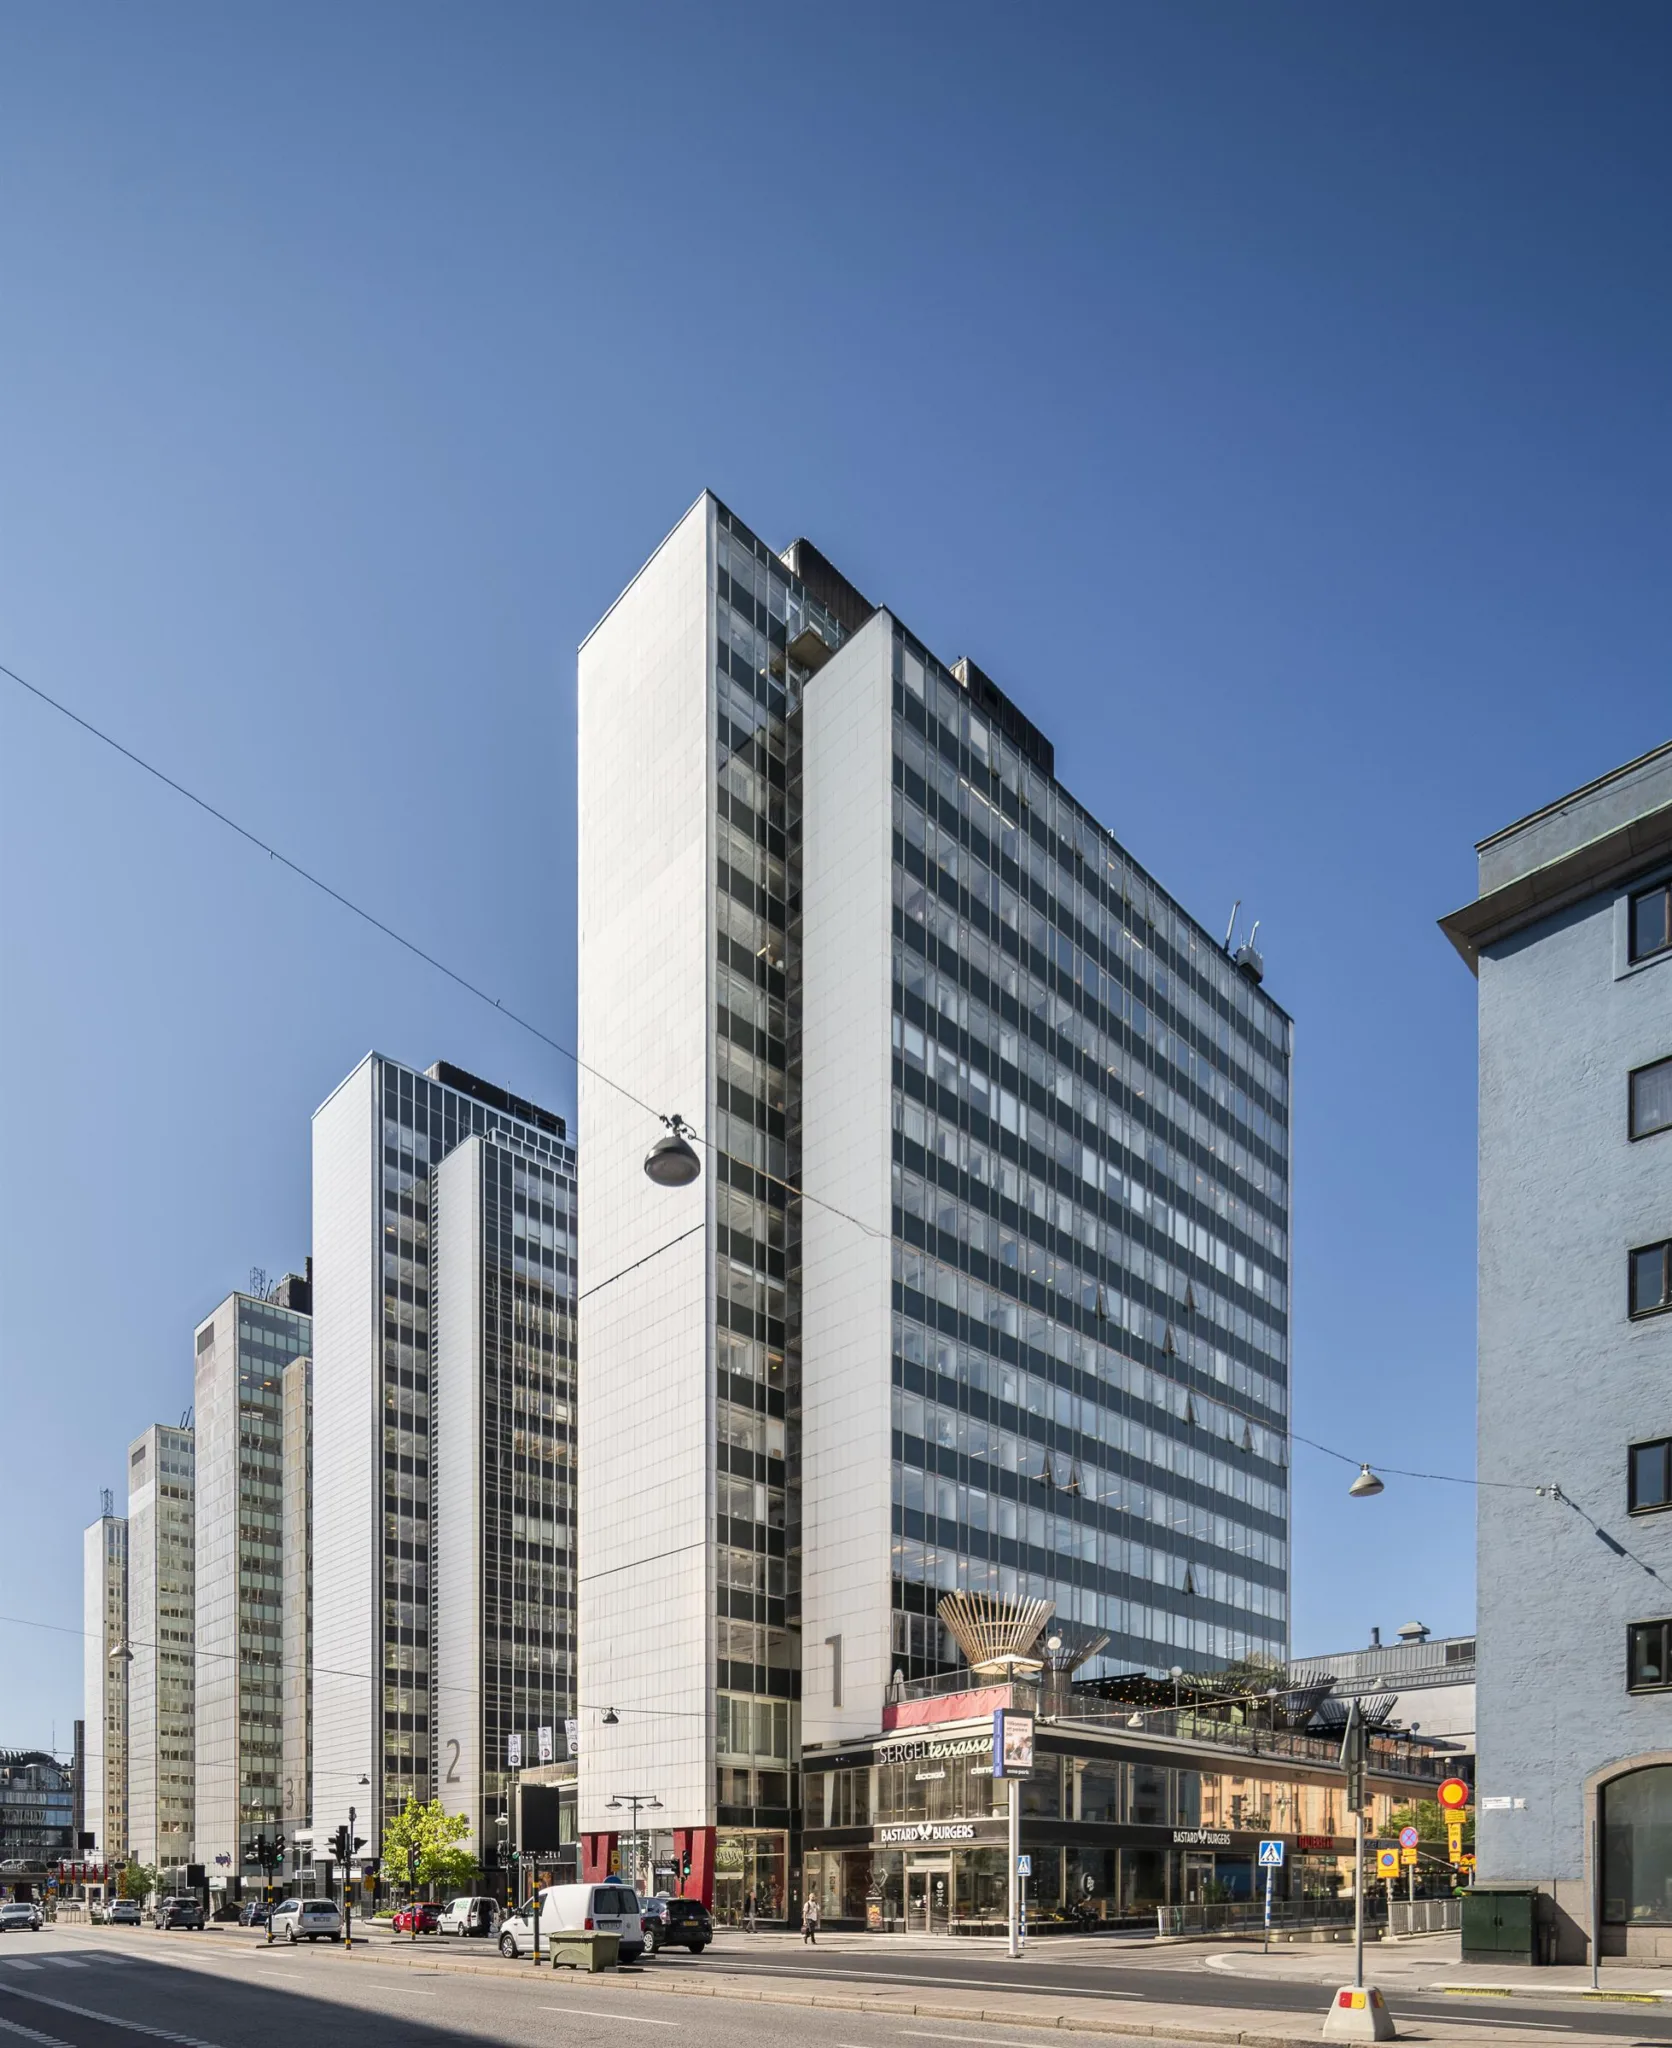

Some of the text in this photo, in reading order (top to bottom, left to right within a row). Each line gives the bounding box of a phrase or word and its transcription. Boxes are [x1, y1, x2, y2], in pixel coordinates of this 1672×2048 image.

[825, 1634, 842, 1707] 1
[446, 1739, 460, 1783] 2
[285, 1777, 294, 1811] 3
[881, 1824, 974, 1842] BASTARD BURGERS
[1173, 1831, 1231, 1845] BASTARD BURGERS
